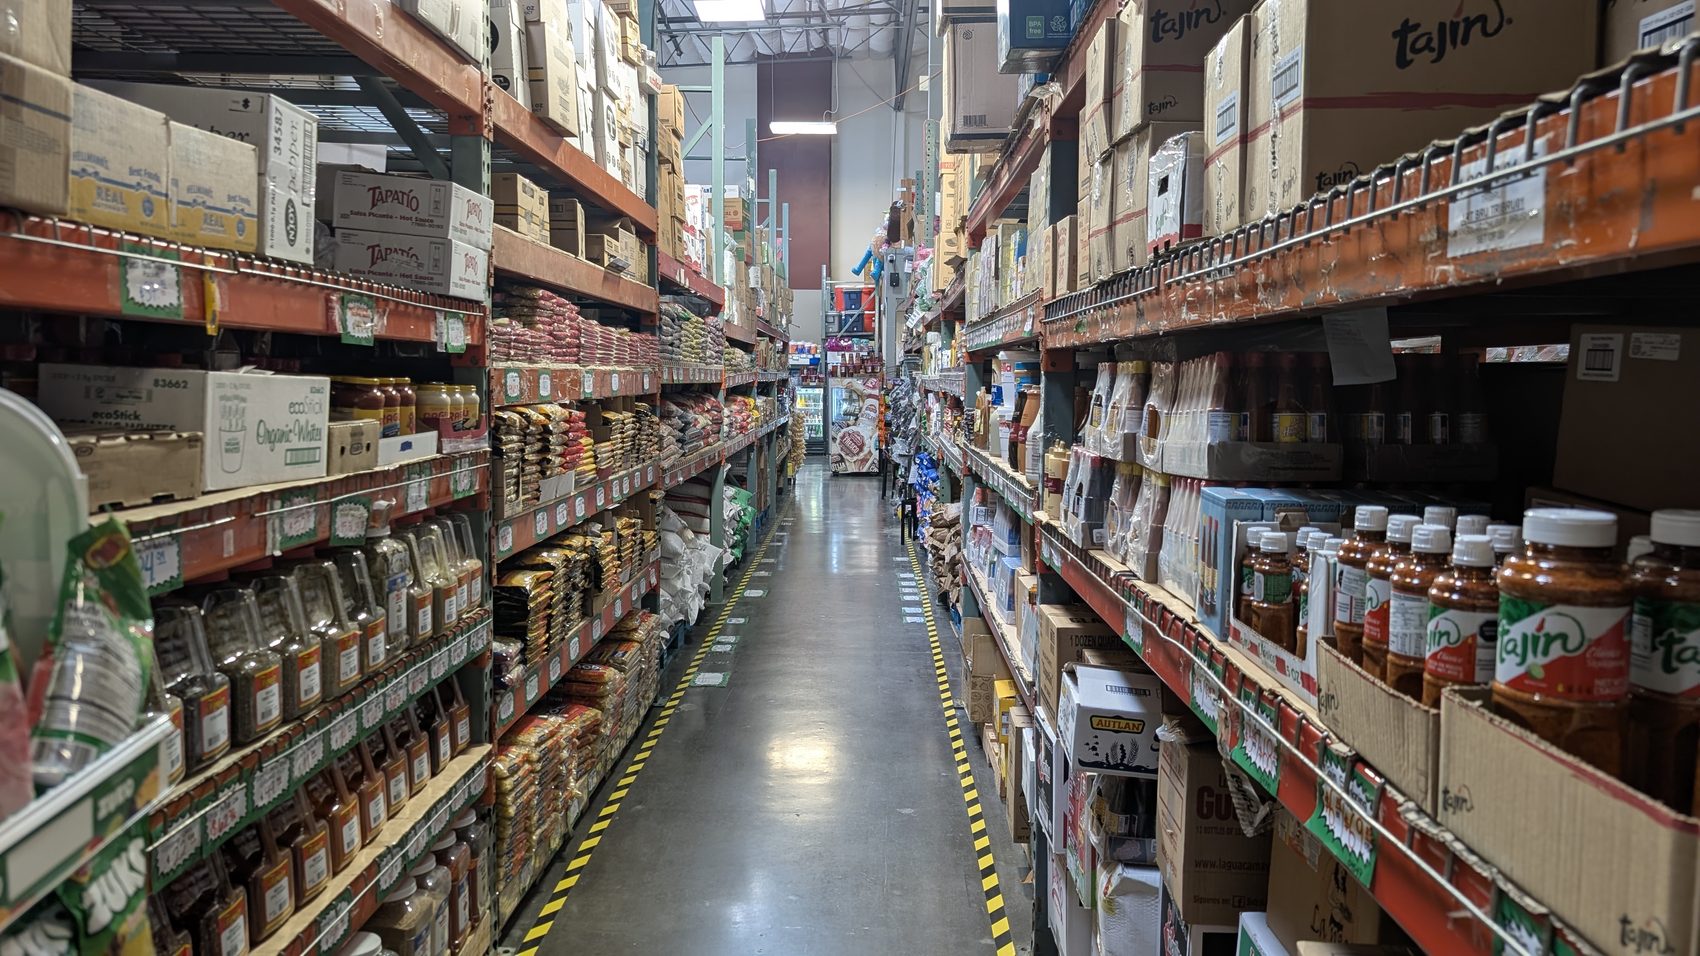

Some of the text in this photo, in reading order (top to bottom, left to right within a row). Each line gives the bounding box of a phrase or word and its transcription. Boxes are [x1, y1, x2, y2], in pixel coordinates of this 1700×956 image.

[273, 106, 285, 156] 34587
[153, 378, 188, 389] 83662
[92, 410, 141, 421] ecoStick
[1075, 634, 1097, 648] DOZEN
[1095, 719, 1142, 731] AUTLAN
